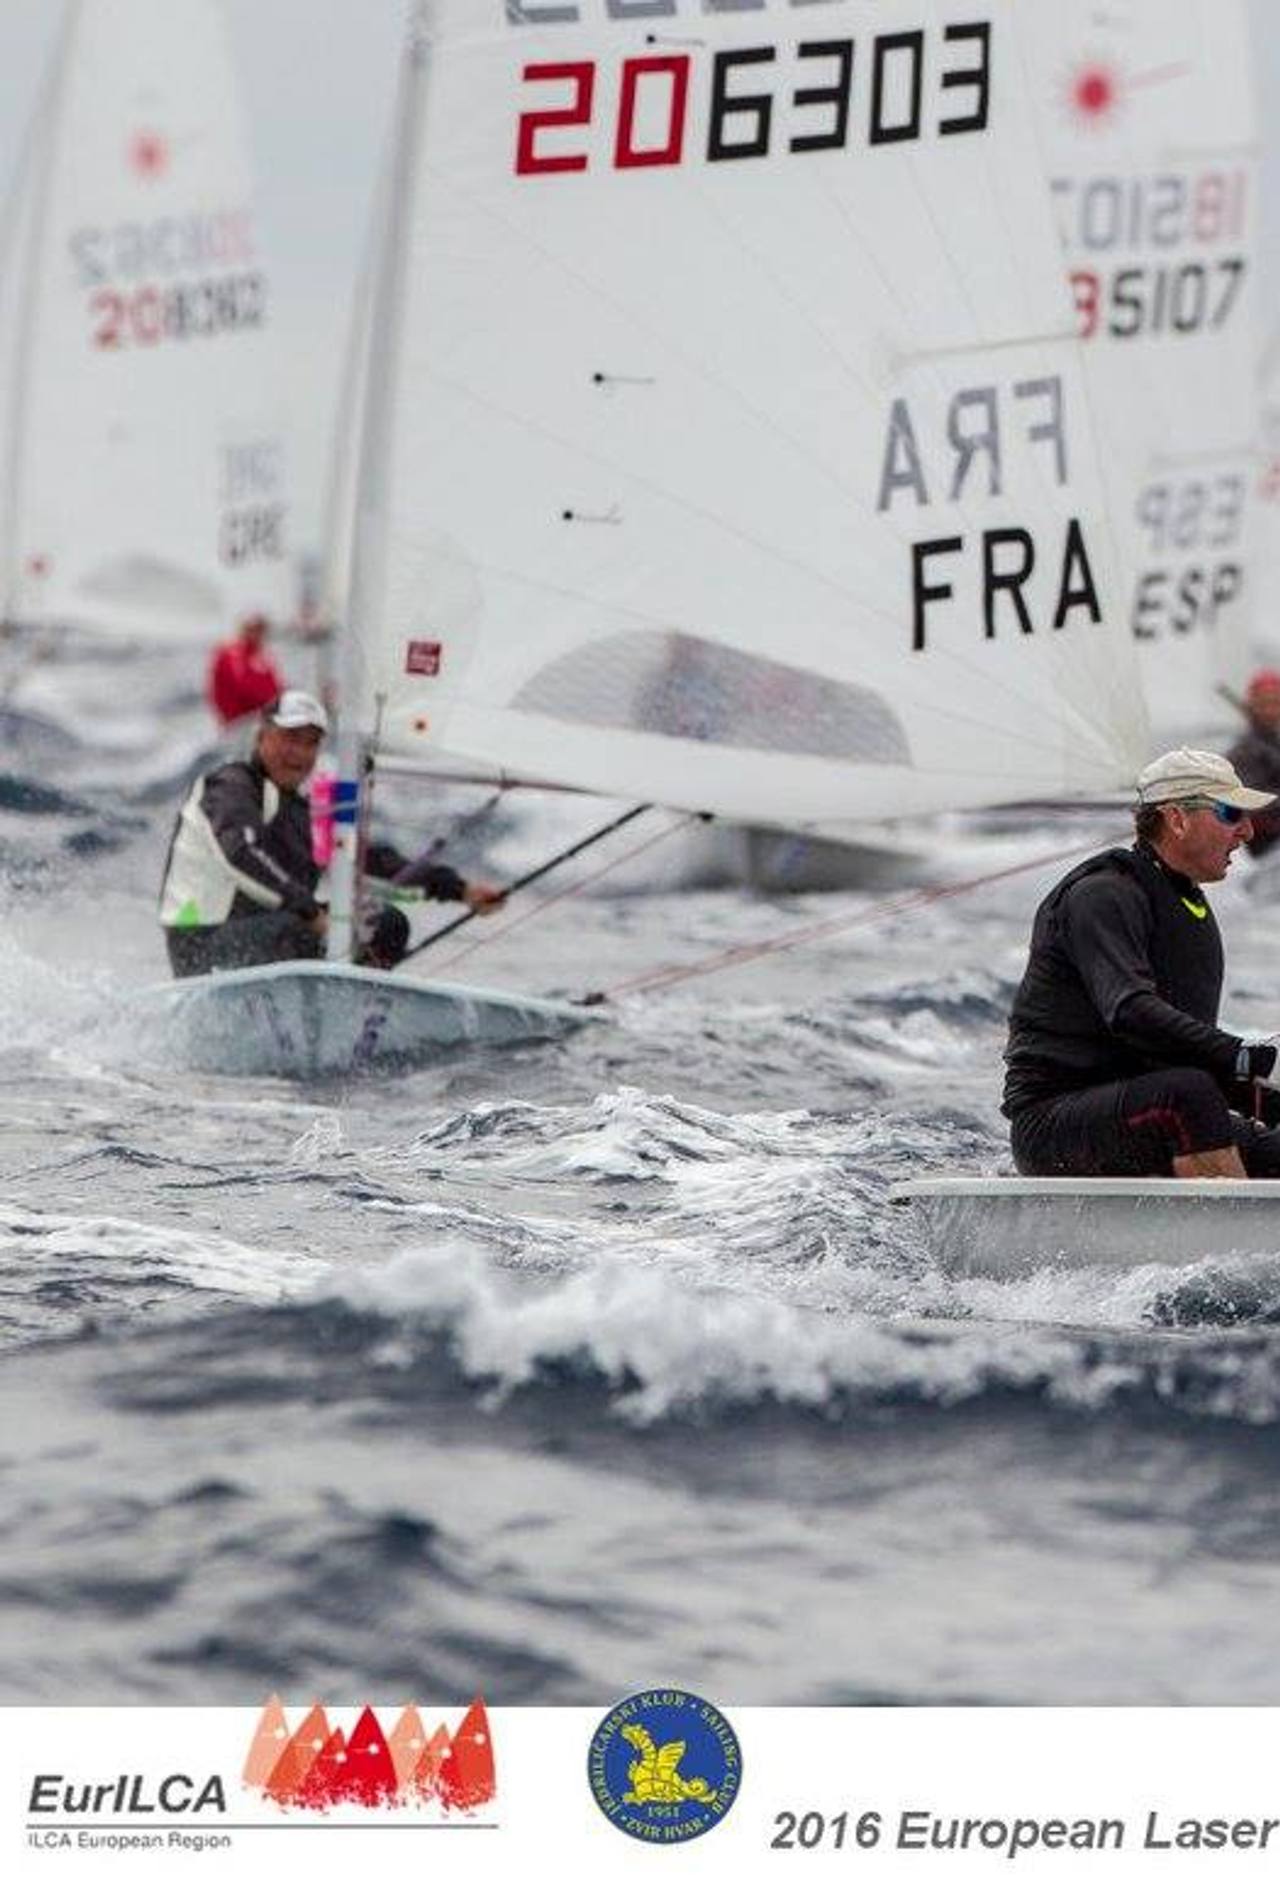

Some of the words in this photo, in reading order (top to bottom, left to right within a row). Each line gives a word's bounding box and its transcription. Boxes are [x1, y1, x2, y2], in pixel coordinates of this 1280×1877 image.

[515, 21, 990, 176] 206303
[912, 518, 1103, 651] FRA
[1131, 563, 1244, 642] ESP
